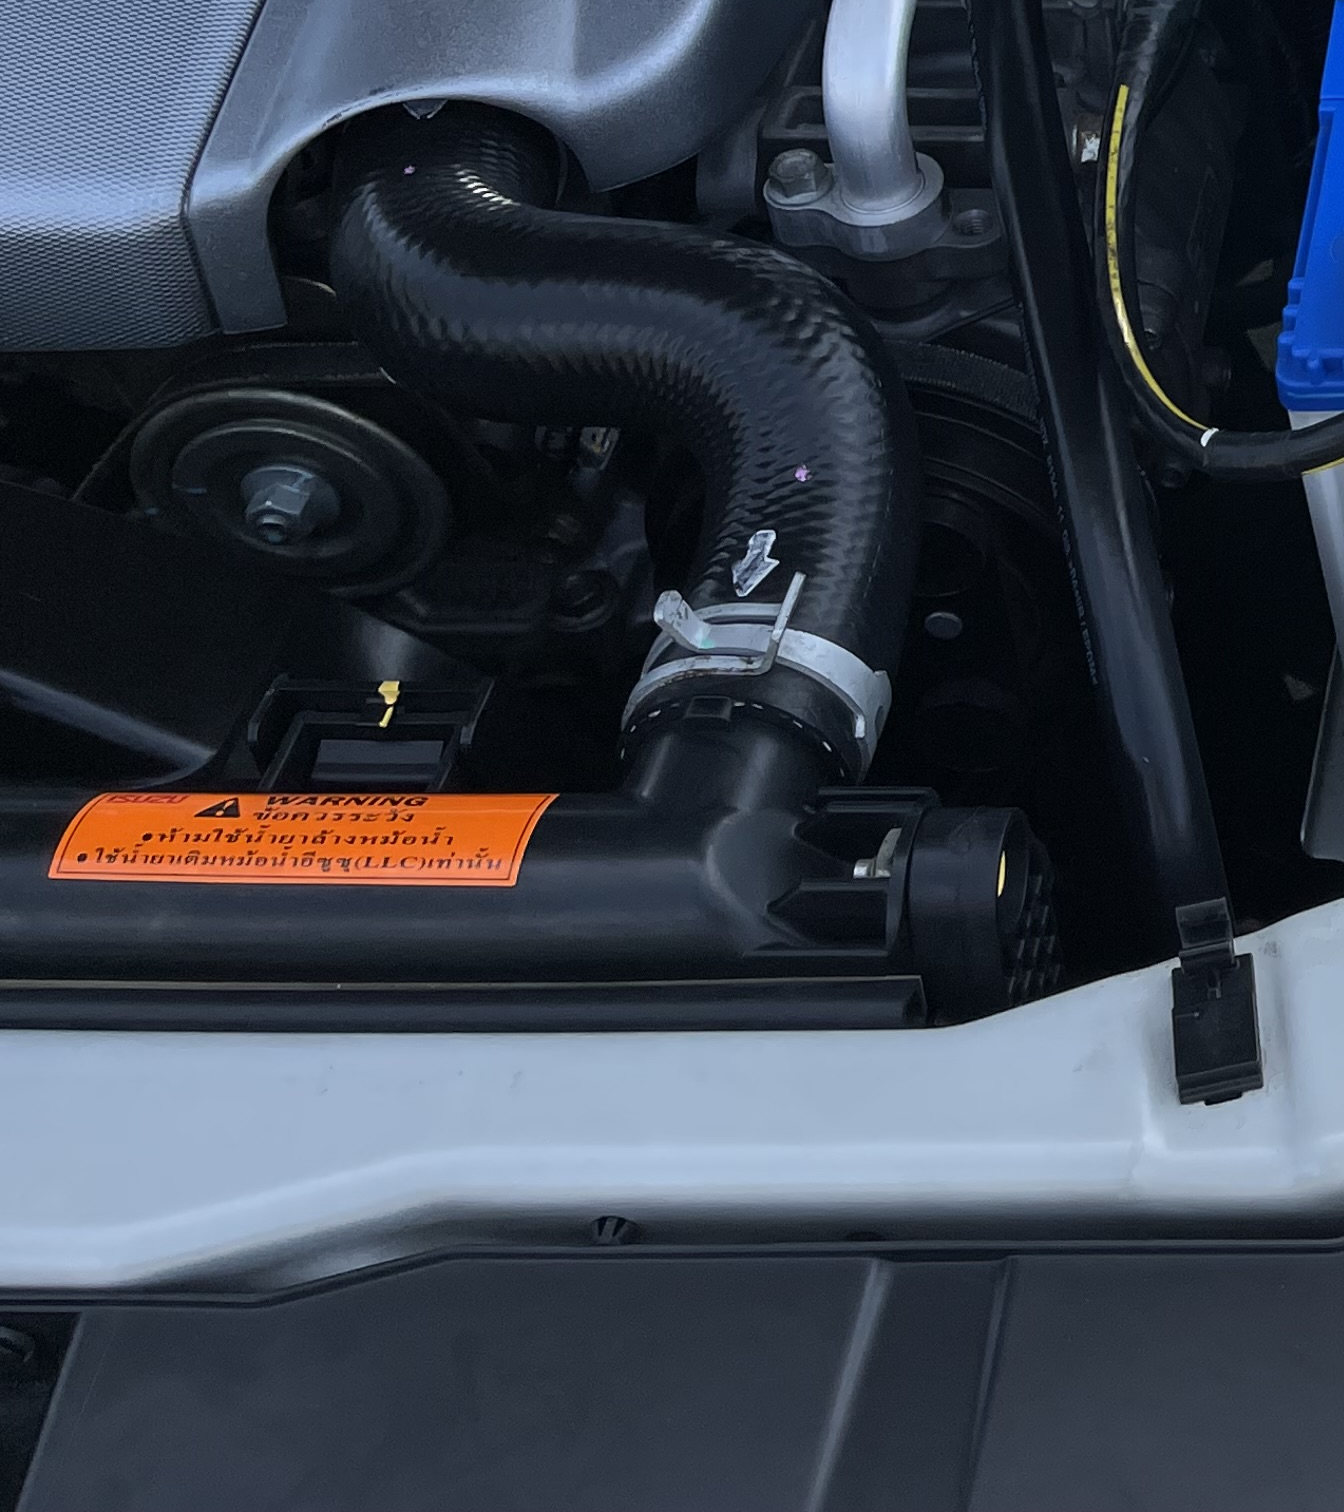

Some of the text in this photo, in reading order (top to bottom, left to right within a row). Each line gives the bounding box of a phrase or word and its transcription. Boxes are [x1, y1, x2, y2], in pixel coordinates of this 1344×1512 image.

[106, 795, 191, 805] ISUZU
[266, 795, 429, 807] WARNING
[253, 806, 415, 822] ข้อควรระวัง
